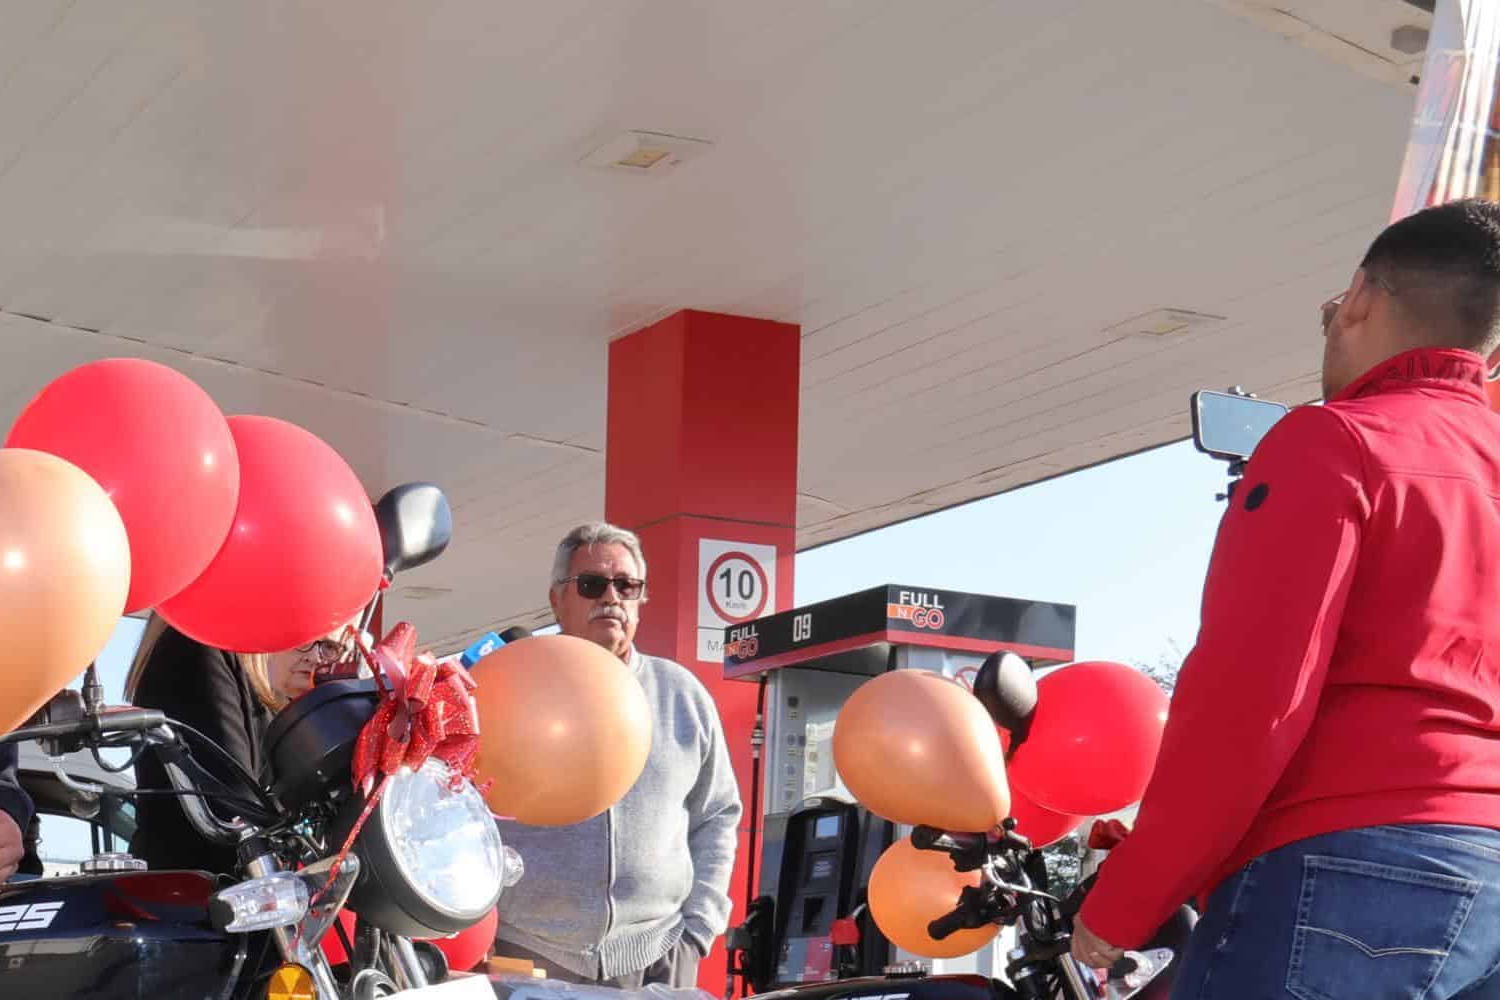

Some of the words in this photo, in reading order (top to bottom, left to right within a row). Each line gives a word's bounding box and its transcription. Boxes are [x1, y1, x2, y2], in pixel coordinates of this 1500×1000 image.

[720, 568, 754, 600] 10
[900, 591, 944, 608] FULL
[793, 614, 812, 642] 09
[913, 607, 944, 629] GO
[730, 624, 759, 642] FULL
